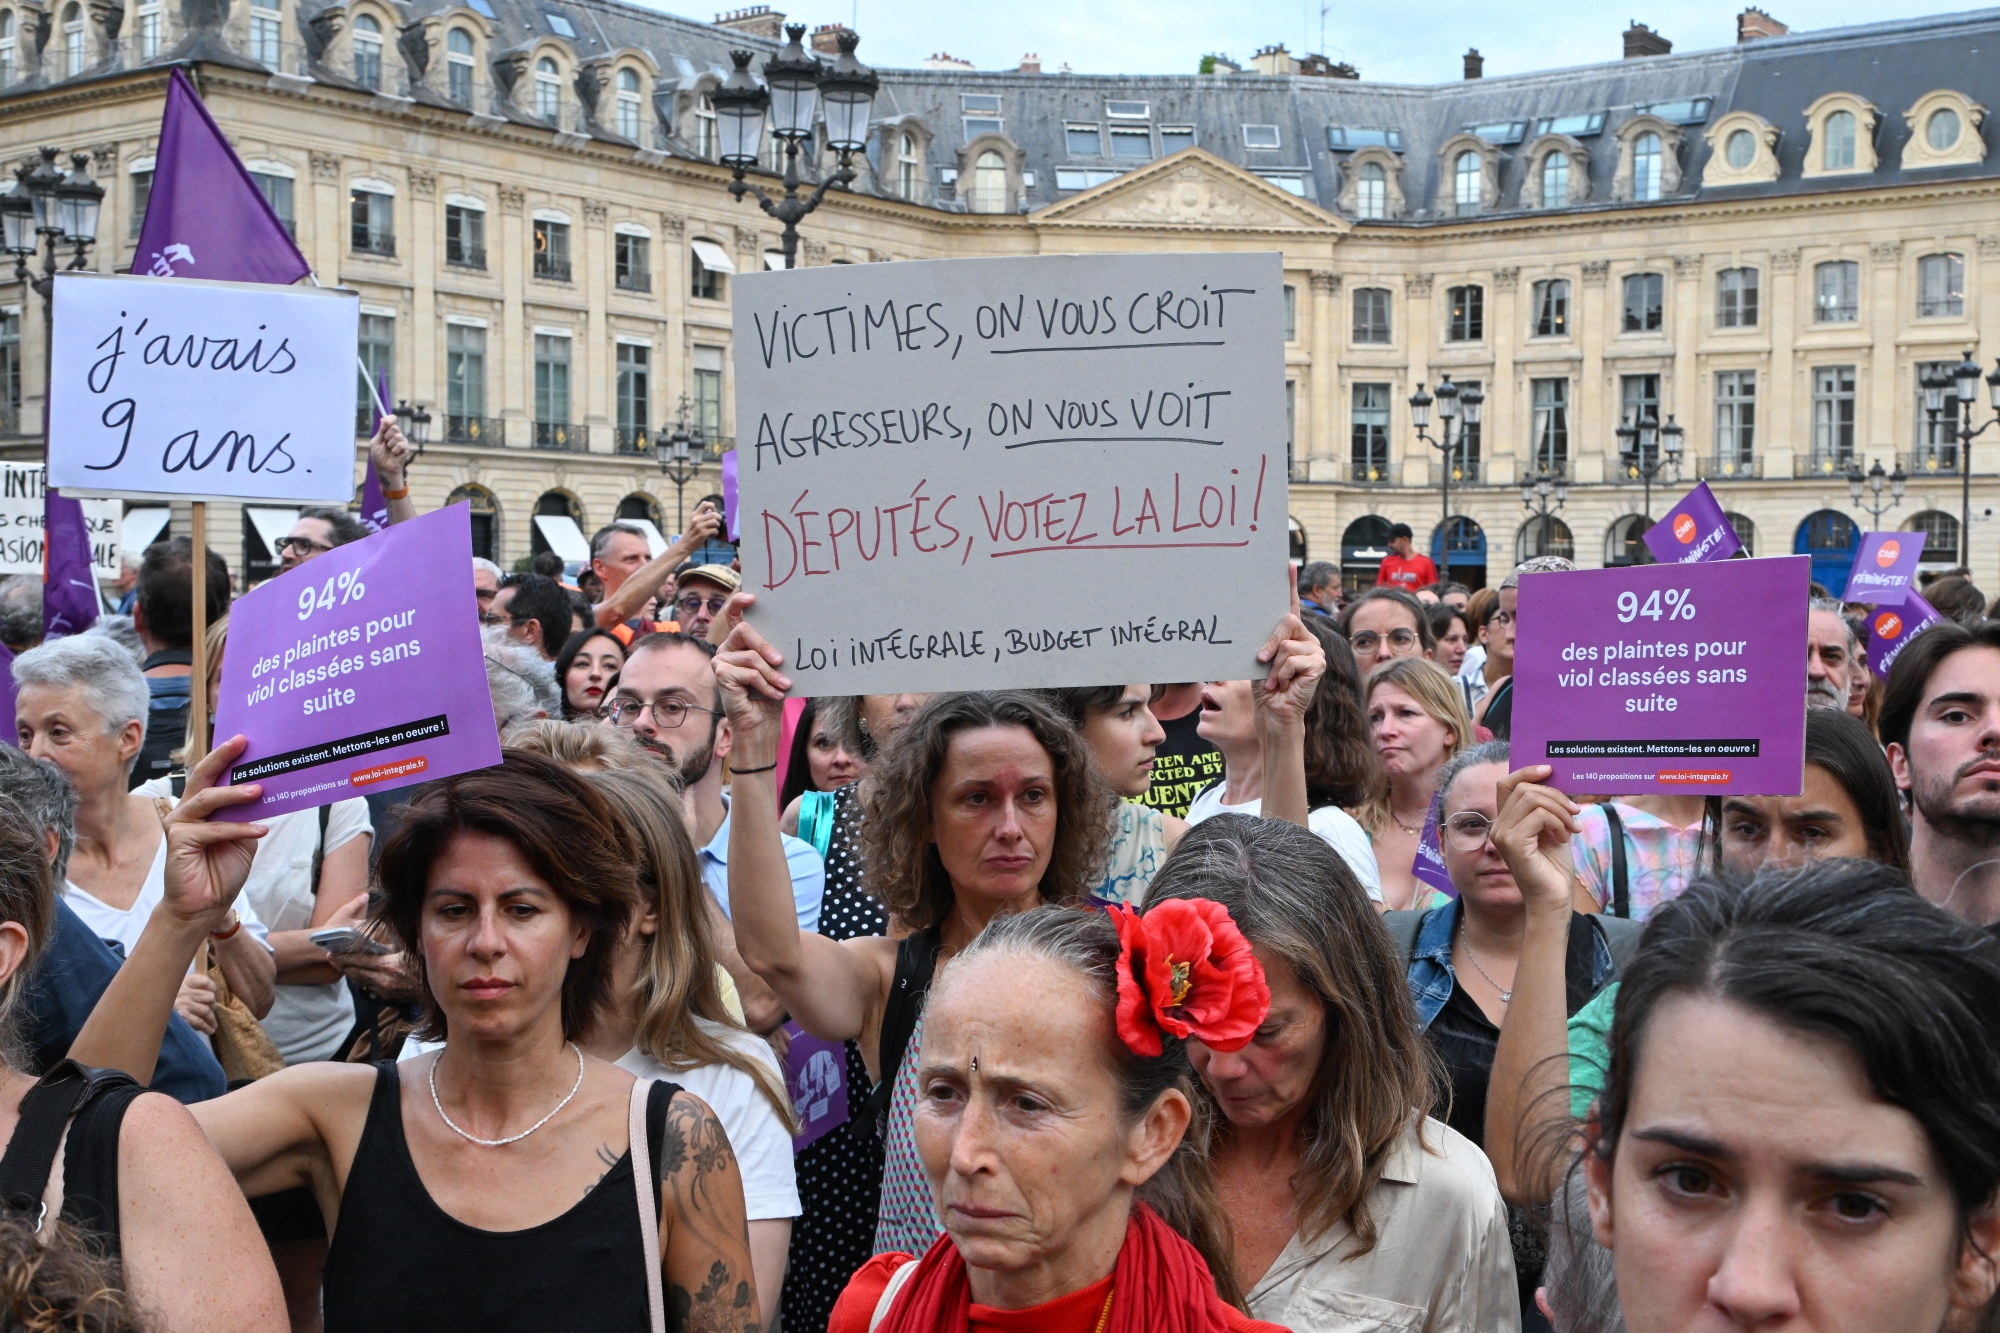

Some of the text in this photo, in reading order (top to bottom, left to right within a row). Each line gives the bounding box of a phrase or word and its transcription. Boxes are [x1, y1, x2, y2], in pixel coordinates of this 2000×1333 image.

[976, 294, 1024, 339] ON
[1036, 295, 1117, 338] VOUS
[88, 310, 296, 394] j'avais
[84, 397, 313, 474] 9 ans.
[754, 402, 972, 471] AGRESSEURS,
[988, 398, 1033, 437] ON
[1045, 399, 1118, 430] VOUS
[85, 517, 114, 533] QUE
[761, 478, 974, 591] DÉPUTÉS,
[978, 490, 1098, 545] VOTEZ
[1112, 486, 1160, 536] LA
[93, 543, 117, 568] ALE
[297, 566, 366, 621] 94%
[1616, 588, 1697, 623] 94%
[251, 608, 416, 679] des plaintes pour
[1004, 627, 1104, 655] BUDGET
[1561, 639, 1747, 665] des plaintes pour
[247, 639, 421, 707] viol classées sans
[1558, 665, 1748, 687] viol classées sans
[302, 687, 356, 715] suite
[1624, 692, 1678, 713] suite
[233, 770, 248, 781] Les
[248, 760, 290, 776] solutions
[291, 749, 332, 766] existent.
[332, 735, 390, 756] Mettons-les
[391, 733, 404, 742] en
[405, 724, 439, 738] oeuvre
[1153, 751, 1221, 769] TEN AND
[1549, 745, 1565, 754] Les
[1566, 745, 1605, 754] solutions
[1606, 745, 1645, 754] existent.
[1646, 744, 1702, 753] Mettons-les
[262, 759, 425, 804] Les 140 propositions sur www.loi-integrale.fr
[1148, 763, 1223, 781] ECTED BY
[1598, 772, 1643, 781] propositions
[1659, 773, 1729, 782] www.loi-integrale.fr
